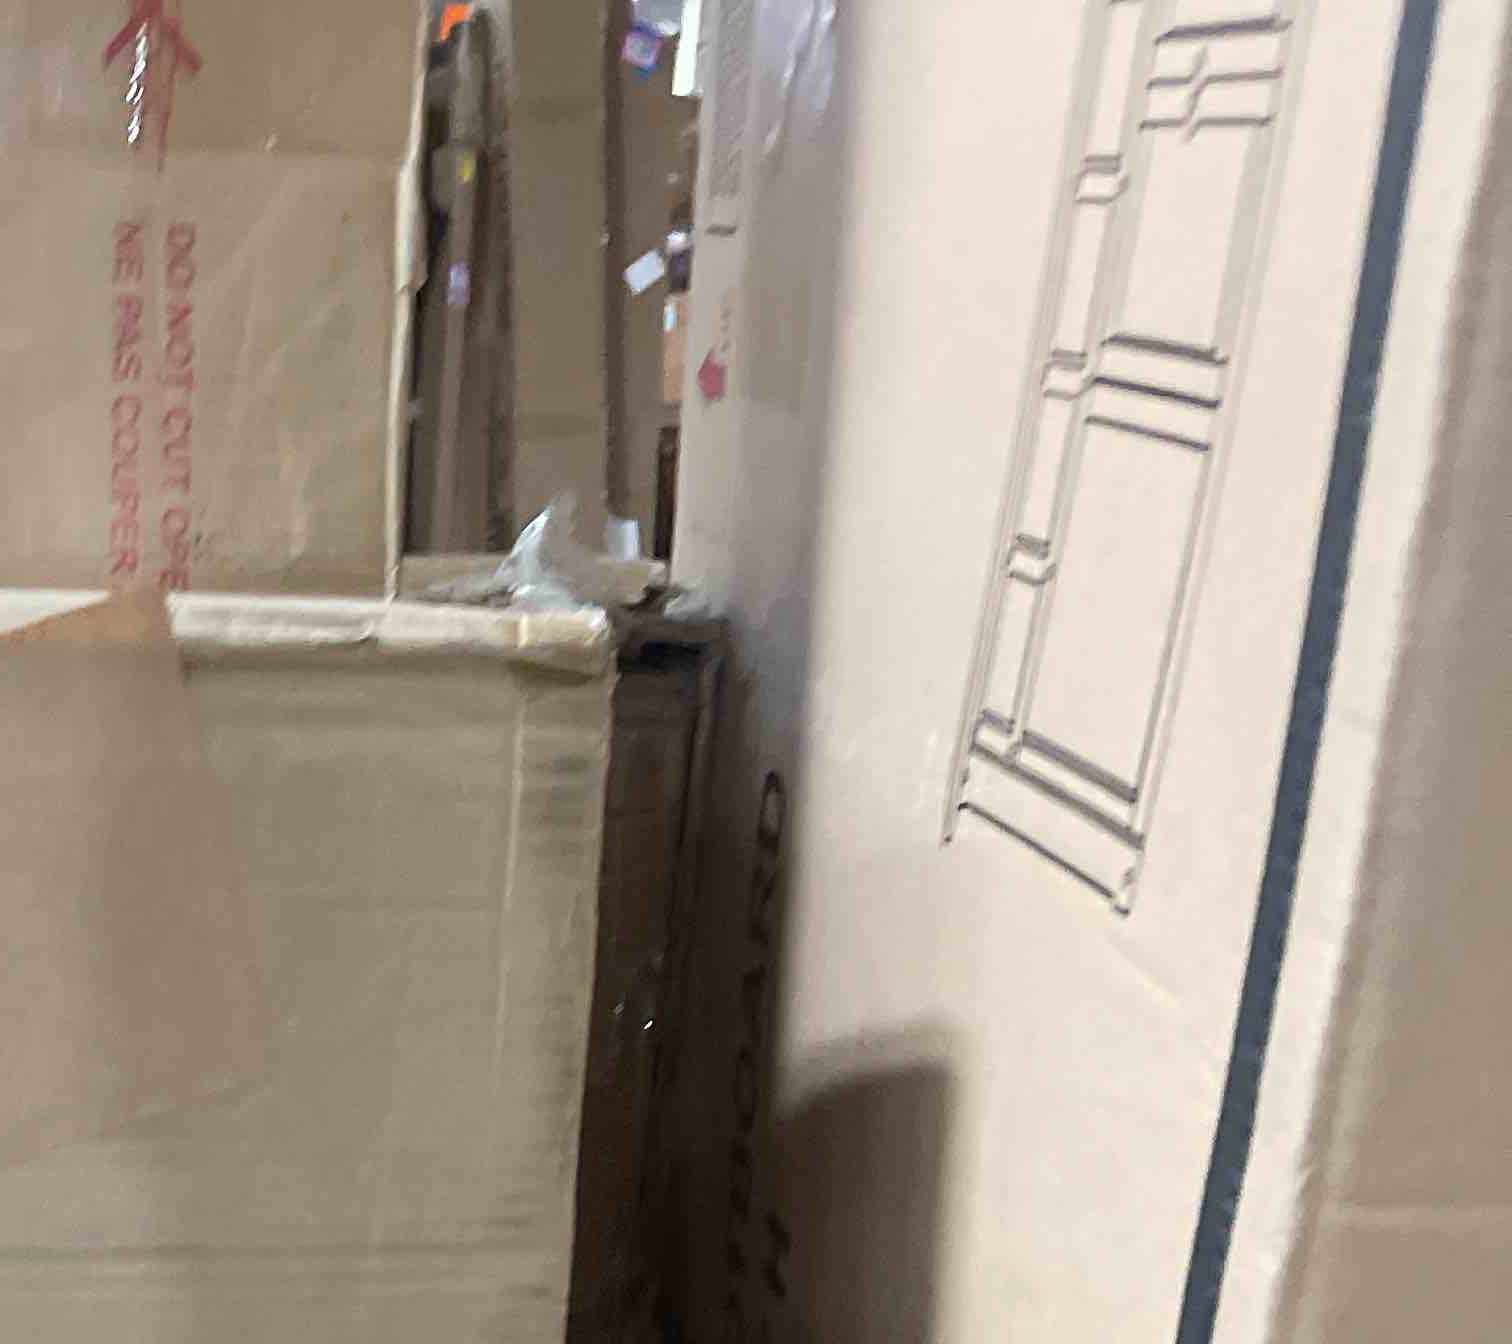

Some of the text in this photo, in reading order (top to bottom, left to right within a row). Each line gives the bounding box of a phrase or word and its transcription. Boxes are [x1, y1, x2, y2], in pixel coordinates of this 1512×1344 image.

[109, 222, 143, 576] NE PAS COUPER
[159, 222, 197, 591] DO NOT CUT OPE
